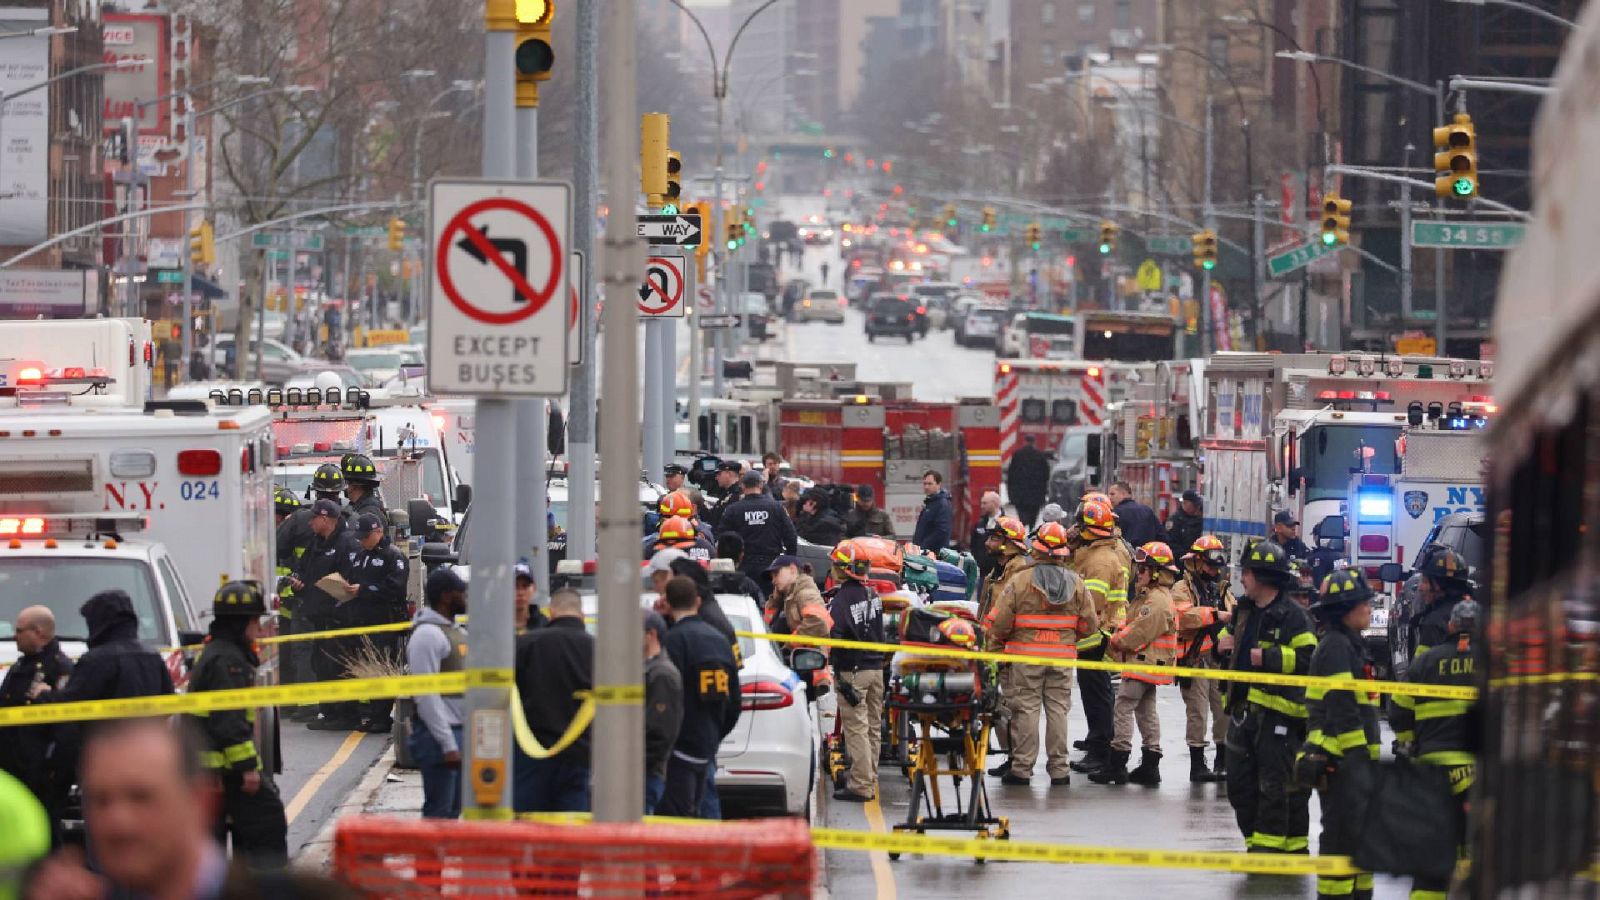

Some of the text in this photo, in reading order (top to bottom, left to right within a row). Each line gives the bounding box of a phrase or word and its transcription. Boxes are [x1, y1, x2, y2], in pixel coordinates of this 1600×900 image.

[662, 224, 691, 236] WAY
[1441, 227, 1502, 243] 34 St
[454, 335, 541, 357] EXCEPT
[458, 363, 536, 384] BUSES
[104, 481, 165, 510] N.Y.
[181, 480, 219, 501] 024
[744, 511, 769, 520] NYPD
